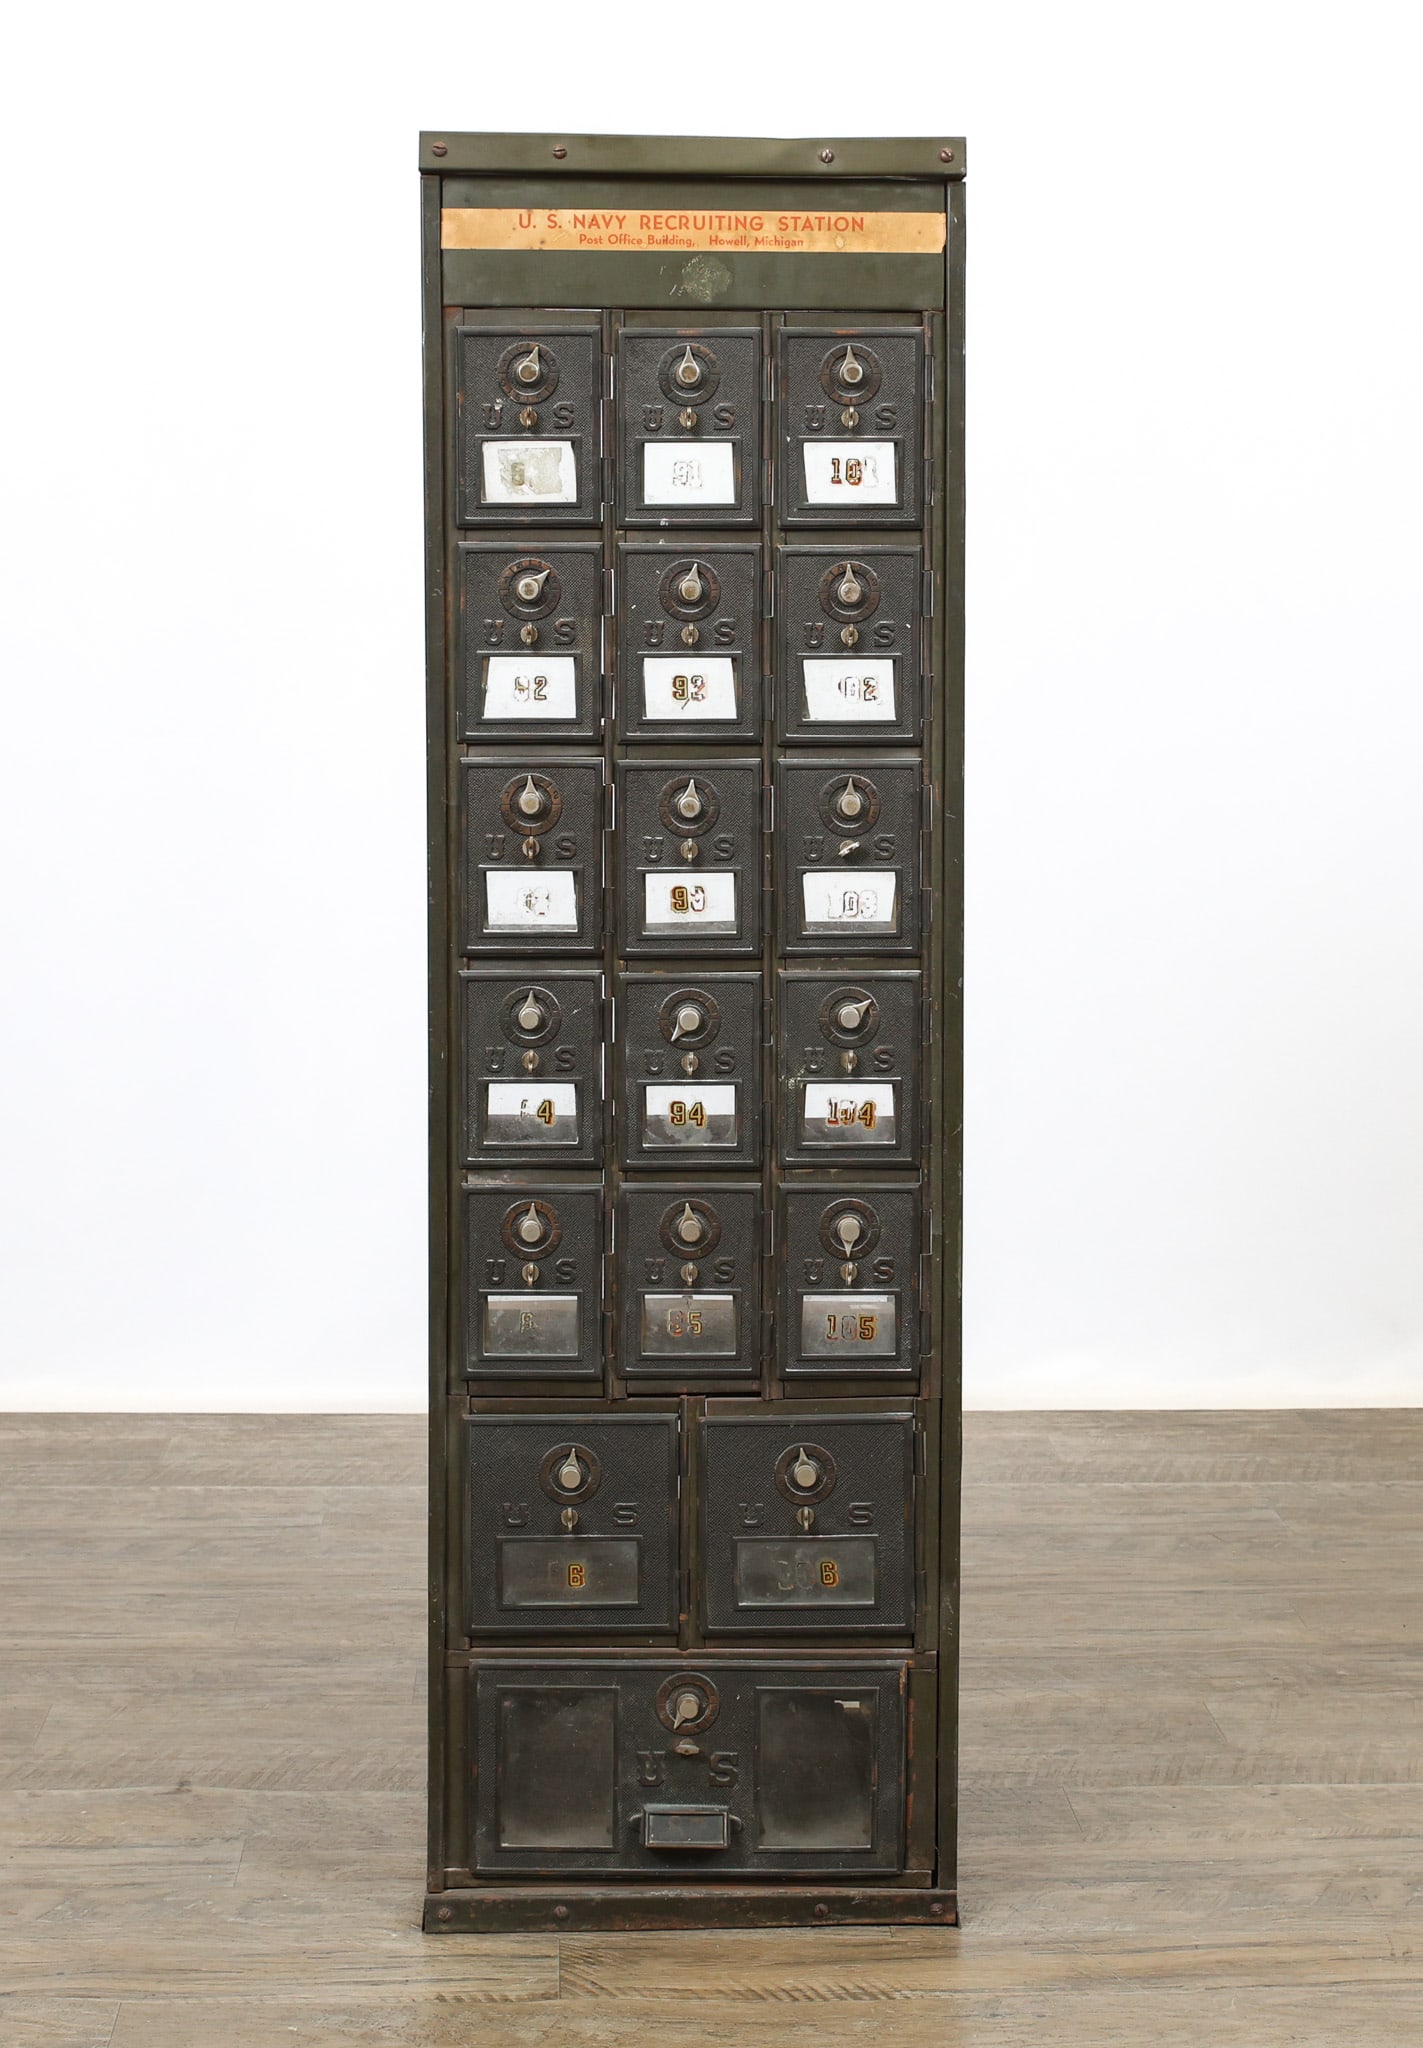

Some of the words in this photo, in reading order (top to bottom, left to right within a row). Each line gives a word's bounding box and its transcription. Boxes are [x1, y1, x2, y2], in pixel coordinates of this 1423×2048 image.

[518, 213, 537, 229] U.
[547, 213, 563, 229] S.
[573, 214, 627, 230] NAVY
[639, 215, 764, 231] RECRUITING
[778, 216, 865, 232] STATION
[579, 233, 604, 245] Post
[608, 233, 643, 246] Office
[647, 234, 696, 248] Building,
[709, 235, 750, 248] Howell,
[754, 235, 804, 249] Michigan
[483, 404, 503, 429] U
[553, 403, 575, 429] S
[641, 405, 663, 431] U
[713, 404, 735, 430] S
[805, 405, 826, 430] U
[875, 404, 897, 430] S
[484, 620, 504, 645] U
[554, 619, 576, 645] S
[644, 621, 665, 646] U
[714, 620, 736, 645] S
[805, 622, 825, 647] U
[874, 620, 896, 647] S
[485, 835, 505, 860] U
[556, 835, 577, 860] S
[643, 836, 664, 862] U
[713, 835, 735, 861] S
[804, 836, 824, 861] U
[874, 834, 895, 860] S
[485, 1047, 505, 1072] U
[555, 1047, 577, 1072] S
[643, 1050, 665, 1075] U
[714, 1048, 735, 1074] S
[805, 1047, 825, 1073] U
[873, 1047, 895, 1072] S
[670, 1100, 707, 1127] 94
[485, 1260, 505, 1284] U
[555, 1259, 577, 1284] S
[644, 1260, 665, 1284] U
[714, 1259, 735, 1284] S
[804, 1260, 824, 1285] U
[873, 1258, 895, 1284] S
[825, 1313, 878, 1342] 105
[503, 1503, 528, 1527] U
[613, 1502, 640, 1527] S
[739, 1503, 764, 1528] U
[848, 1502, 874, 1527] S
[636, 1751, 666, 1788] U
[709, 1751, 740, 1788] S
